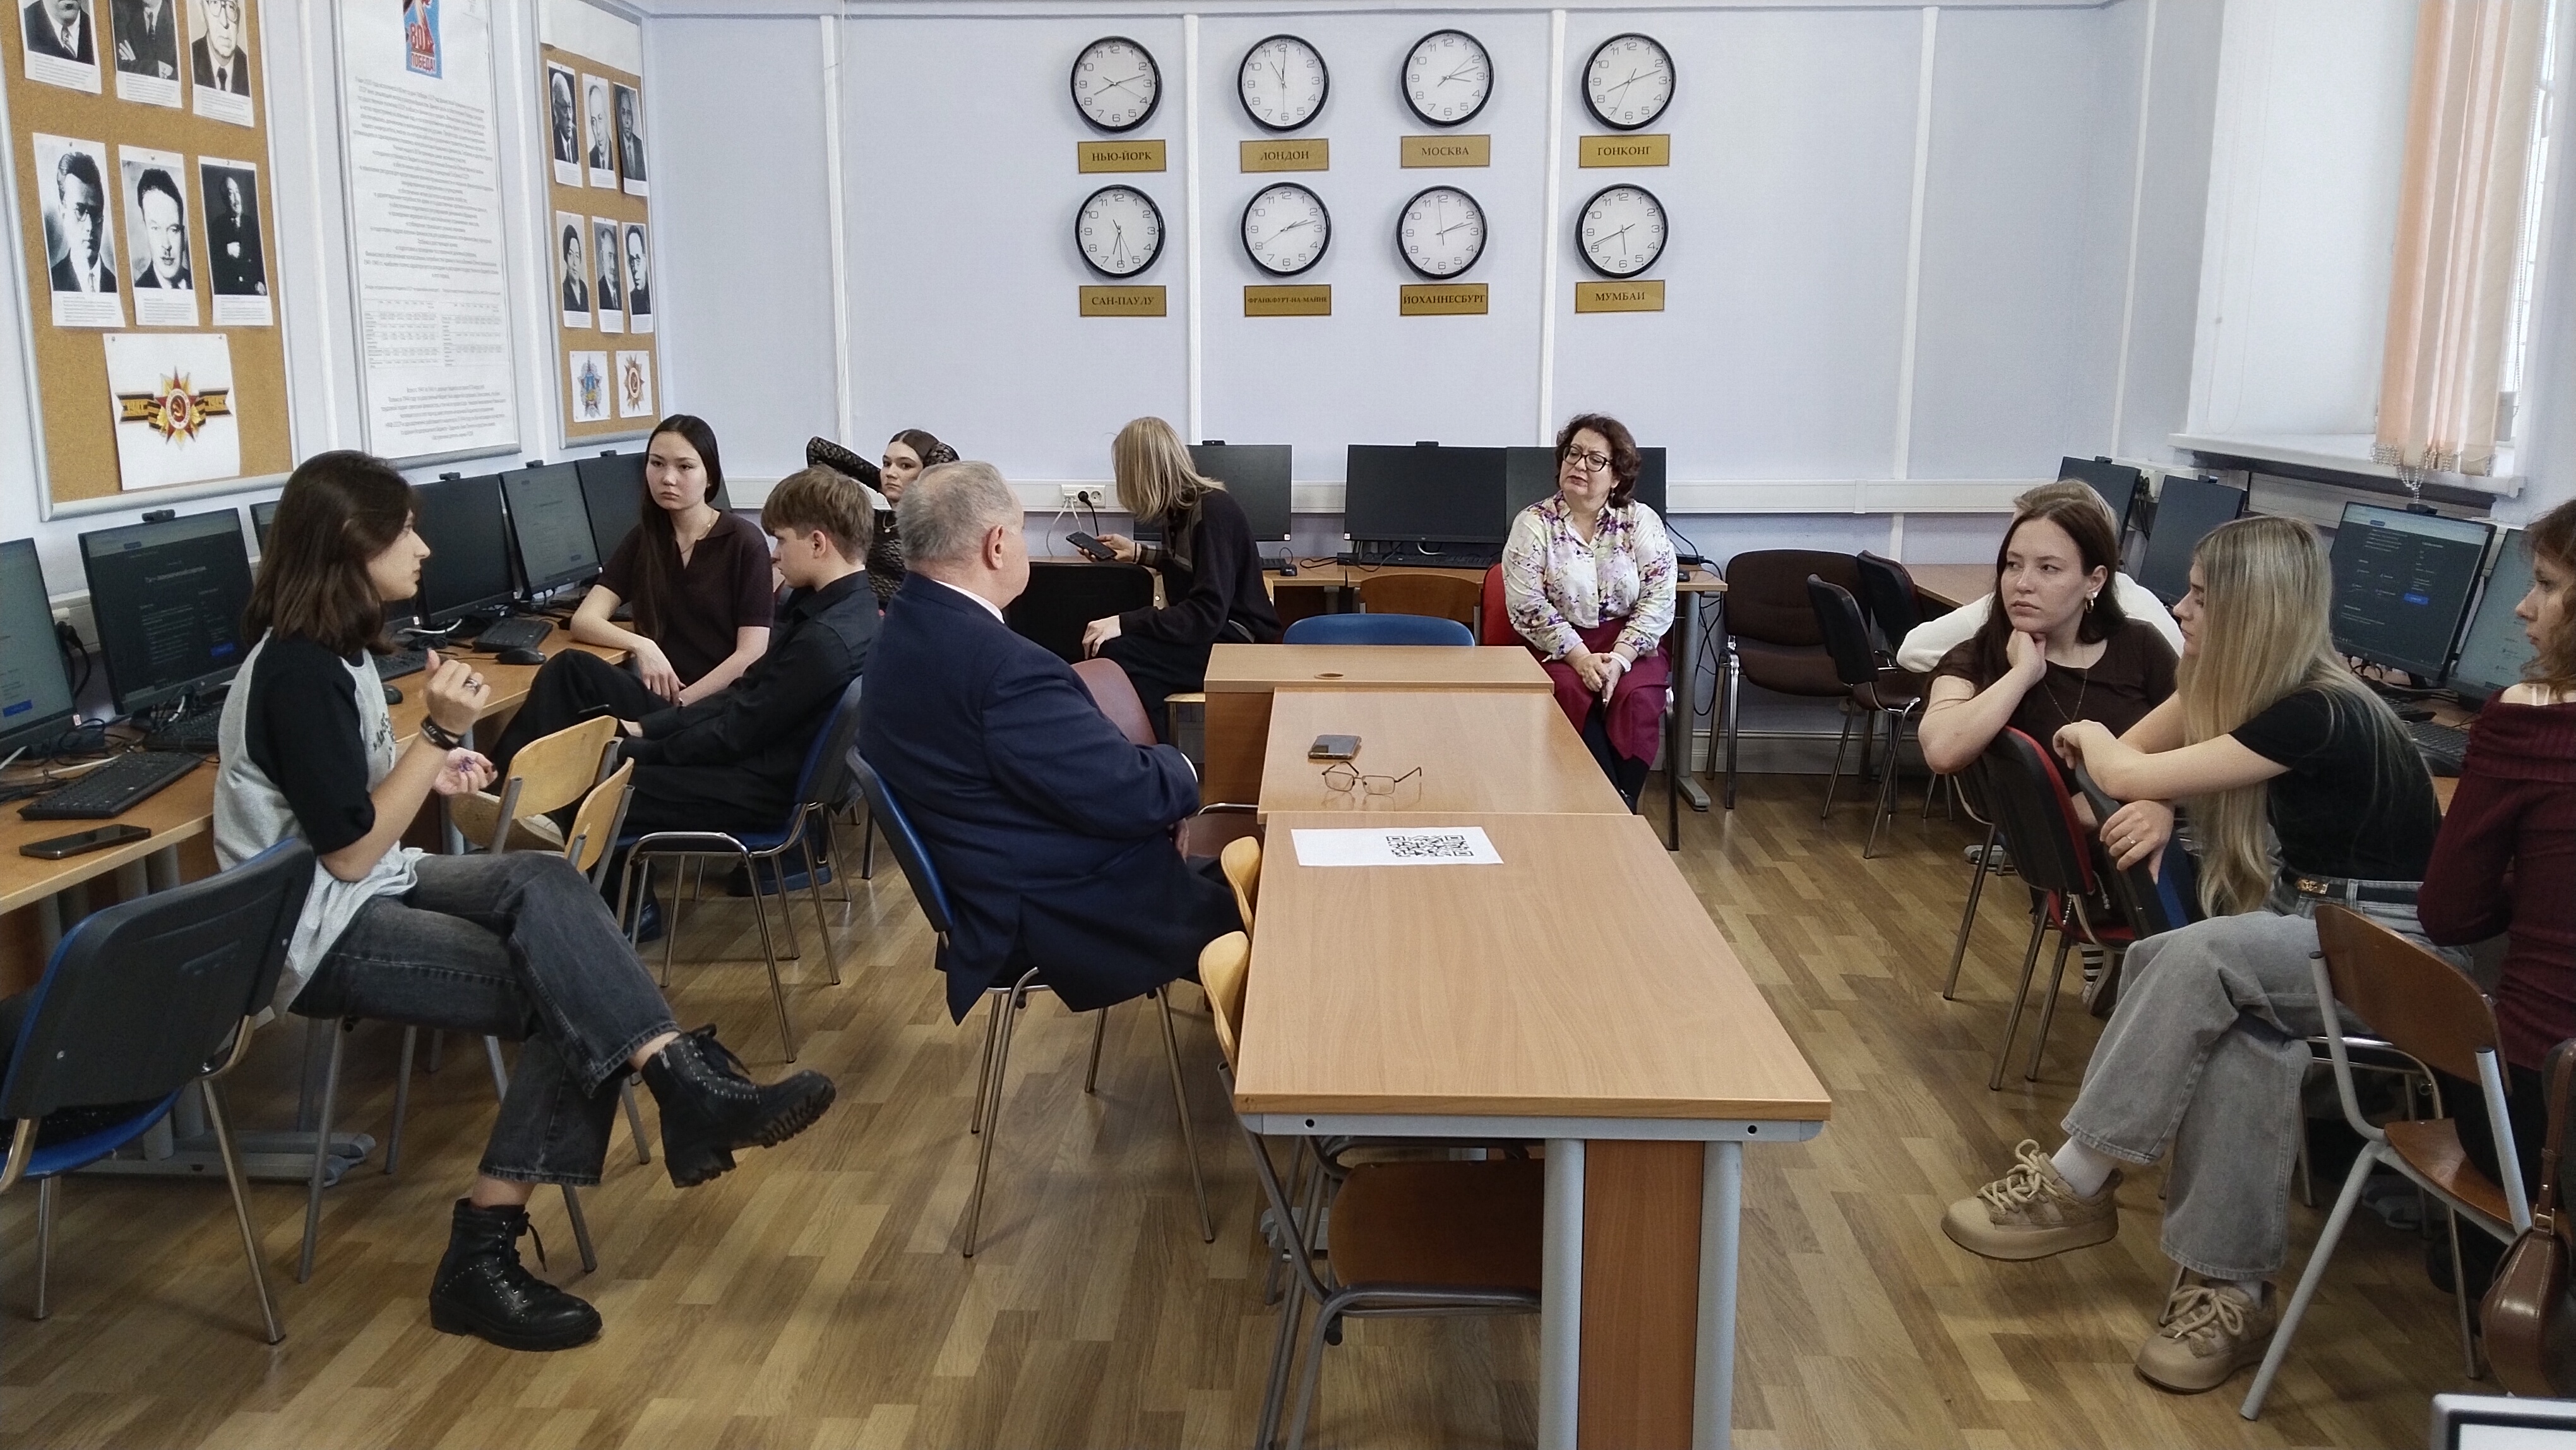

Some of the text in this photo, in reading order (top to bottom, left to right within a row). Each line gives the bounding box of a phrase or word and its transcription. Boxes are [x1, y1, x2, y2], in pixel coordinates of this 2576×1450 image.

[410, 23, 423, 49] 80
[1441, 39, 1454, 47] 12
[1624, 42, 1637, 51] 12
[1108, 45, 1120, 54] 12
[1275, 44, 1287, 52] 12
[1296, 47, 1301, 56] 1
[1428, 44, 1436, 52] 11
[1611, 47, 1619, 56] 11
[1645, 46, 1650, 55] 1
[1095, 50, 1103, 59] 11
[1262, 49, 1271, 57] 11
[411, 53, 435, 71] ПОБЕДА!
[1414, 57, 1427, 65] 10
[1472, 54, 1481, 64] 2
[1082, 63, 1094, 71] 10
[1138, 62, 1147, 71] 2
[1249, 63, 1261, 71] 10
[1306, 59, 1315, 68] 2
[1595, 60, 1609, 69] 10
[1655, 59, 1664, 68] 2
[1412, 74, 1420, 82] 9
[1476, 72, 1485, 80] 3
[1079, 80, 1087, 88] 9
[1143, 80, 1152, 88] 3
[1311, 76, 1320, 85] 3
[1593, 78, 1601, 86] 9
[1659, 76, 1667, 85] 3
[1416, 91, 1424, 100] 8
[1472, 90, 1480, 98] 4
[1084, 97, 1092, 105] 8
[1252, 97, 1260, 105] 8
[1597, 95, 1606, 103] 8
[1428, 104, 1436, 112] 7
[1460, 102, 1469, 111] 5
[1642, 106, 1650, 115] 5
[1096, 110, 1104, 118] 7
[1128, 109, 1136, 117] 5
[1265, 109, 1273, 117] 7
[1297, 107, 1305, 116] 5
[1444, 107, 1452, 116] 6
[1608, 107, 1617, 116] 7
[1625, 111, 1633, 120] 6
[1112, 114, 1121, 122] 6
[1421, 147, 1469, 155] МОСКВА
[1597, 146, 1652, 155] ГОНКОНГ
[1092, 151, 1152, 161] НЬЮ-ЙОРК
[1260, 150, 1309, 160] ЛОНДОН
[1112, 193, 1124, 202] 12
[1279, 191, 1292, 200] 12
[1436, 195, 1448, 203] 12
[1616, 193, 1629, 201] 12
[1099, 198, 1108, 207] 11
[1133, 198, 1137, 206] 1
[1637, 196, 1642, 205] 1
[1086, 211, 1099, 219] 10
[1142, 210, 1151, 219] 2
[1253, 208, 1265, 217] 10
[1309, 208, 1318, 216] 2
[1466, 211, 1474, 219] 2
[1589, 211, 1602, 219] 10
[1647, 208, 1655, 217] 2
[1084, 227, 1092, 236] 9
[1147, 227, 1155, 235] 3
[1251, 225, 1258, 234] 9
[1406, 229, 1414, 237] 9
[1470, 227, 1479, 236] 3
[1587, 228, 1595, 236] 9
[1652, 225, 1660, 233] 3
[1088, 244, 1097, 252] 8
[1255, 242, 1263, 250] 8
[1465, 244, 1474, 253] 4
[1590, 244, 1599, 253] 8
[1100, 256, 1109, 264] 7
[1132, 255, 1141, 264] 5
[1267, 254, 1275, 262] 7
[1298, 253, 1306, 261] 5
[1422, 257, 1430, 265] 7
[1454, 257, 1462, 265] 5
[1602, 256, 1611, 265] 7
[1635, 255, 1643, 263] 5
[1117, 260, 1125, 268] 6
[1438, 261, 1446, 270] 6
[1619, 260, 1627, 268] 6
[1091, 297, 1154, 305] САН-ПАУЛУ
[1403, 294, 1486, 304] ЙОХАННЕСБУРГ
